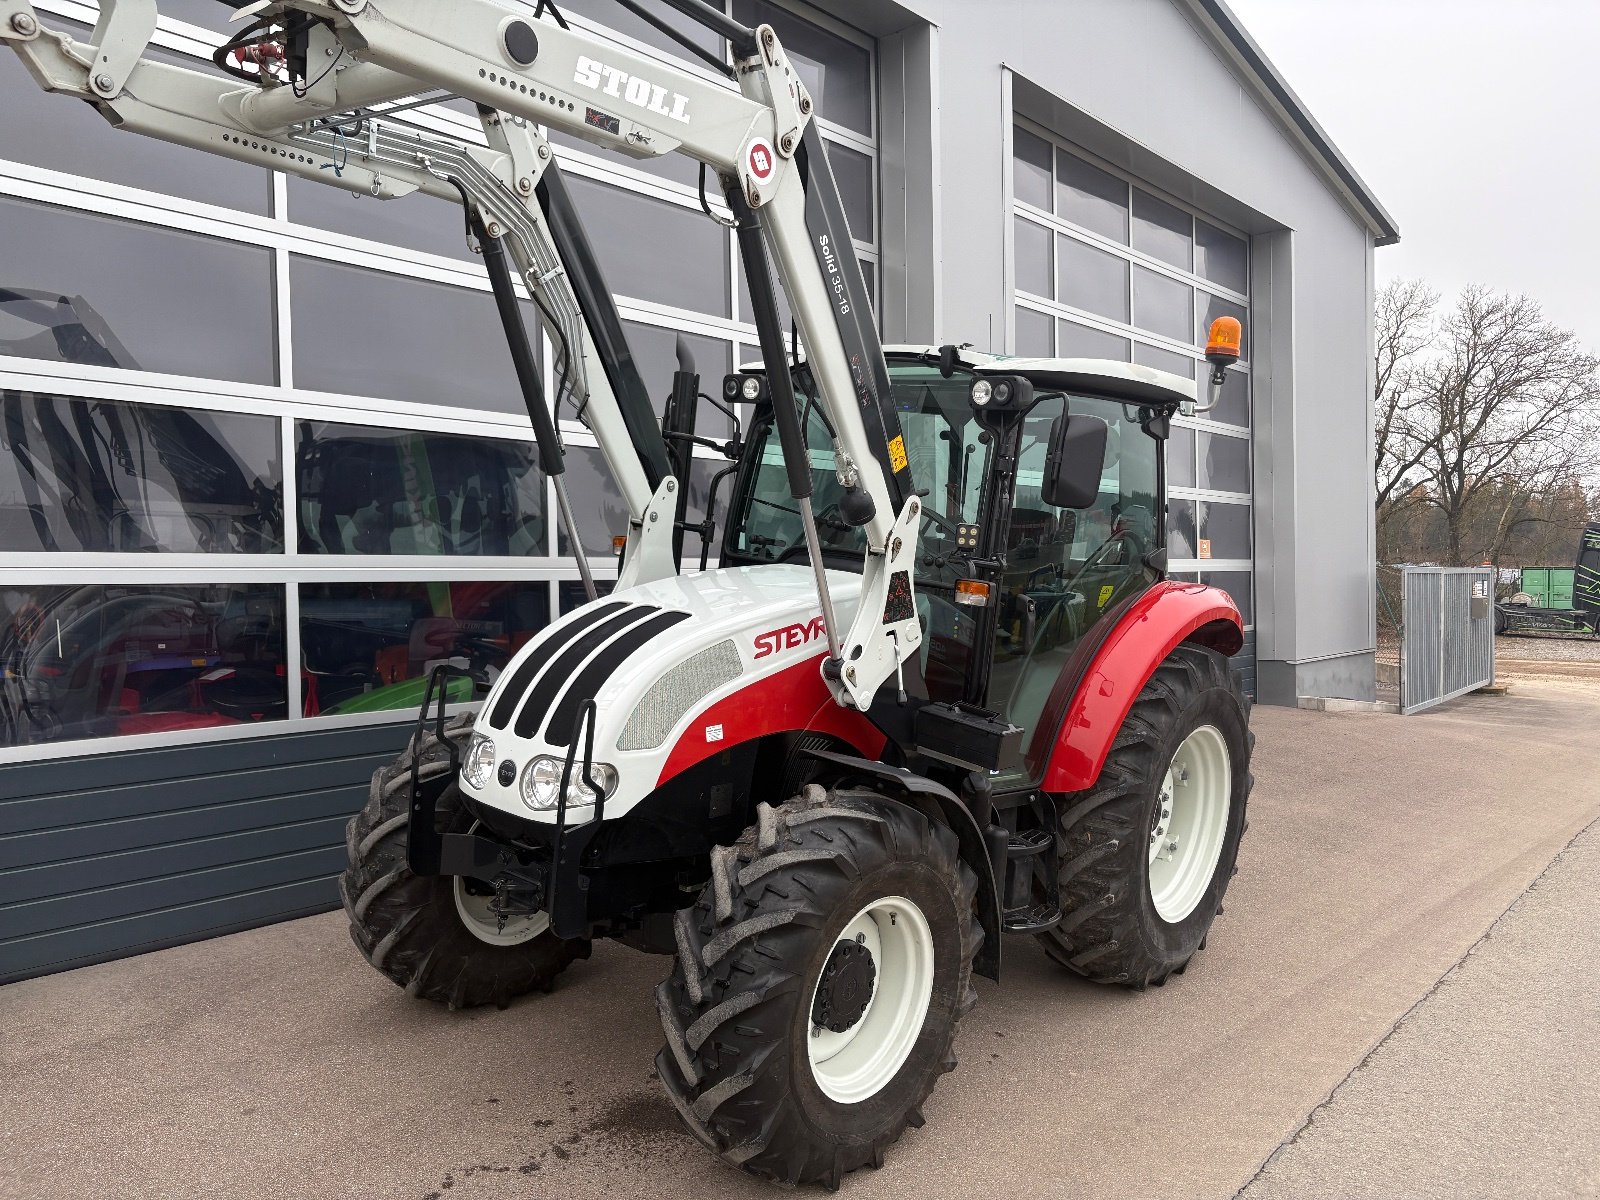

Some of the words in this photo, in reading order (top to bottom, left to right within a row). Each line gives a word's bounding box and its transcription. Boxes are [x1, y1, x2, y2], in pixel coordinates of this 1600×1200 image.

[574, 56, 690, 124] STOLL
[820, 235, 837, 273] Solid
[832, 276, 849, 314] 35-18
